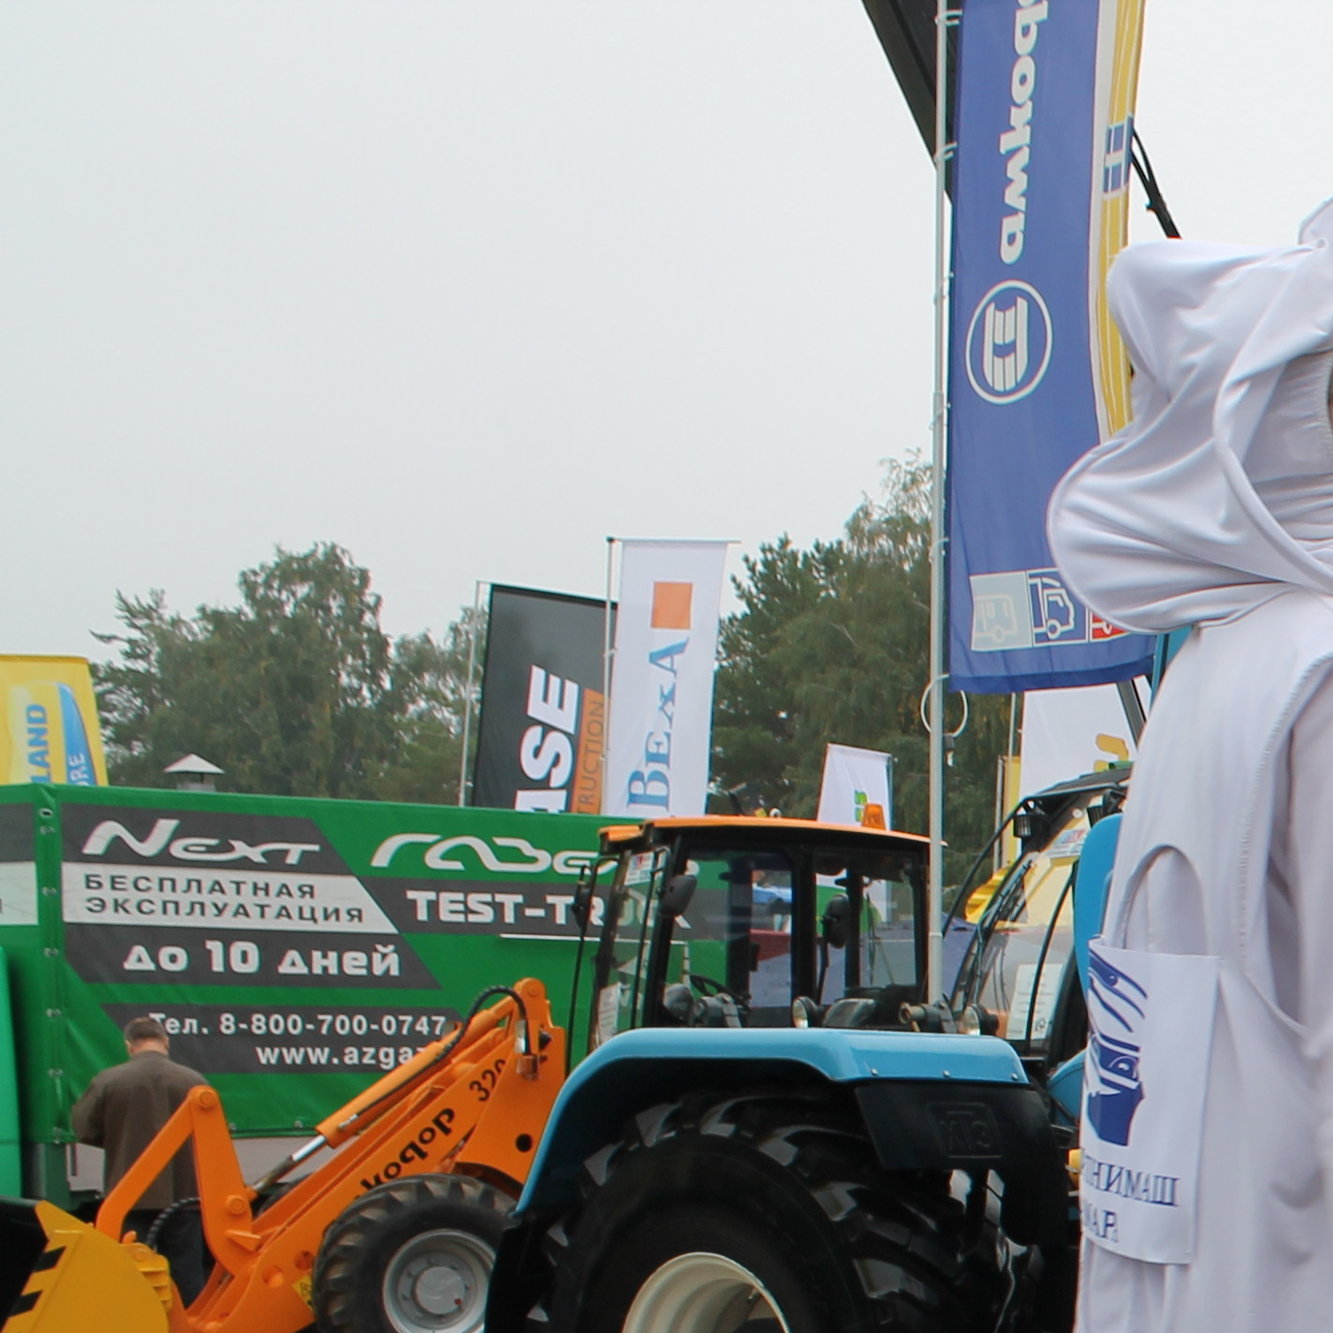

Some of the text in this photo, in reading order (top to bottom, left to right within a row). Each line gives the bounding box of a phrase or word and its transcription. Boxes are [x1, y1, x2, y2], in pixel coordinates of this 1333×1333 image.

[1000, 0, 1049, 265] амкод
[84, 873, 315, 899] БЕСПЛАТНАЯ
[85, 896, 364, 924] ЭКСПЛУАТАЦИЯ
[204, 940, 260, 973] 10
[219, 1012, 447, 1036] 8-800-700-0747
[255, 1045, 426, 1070] www.azga
